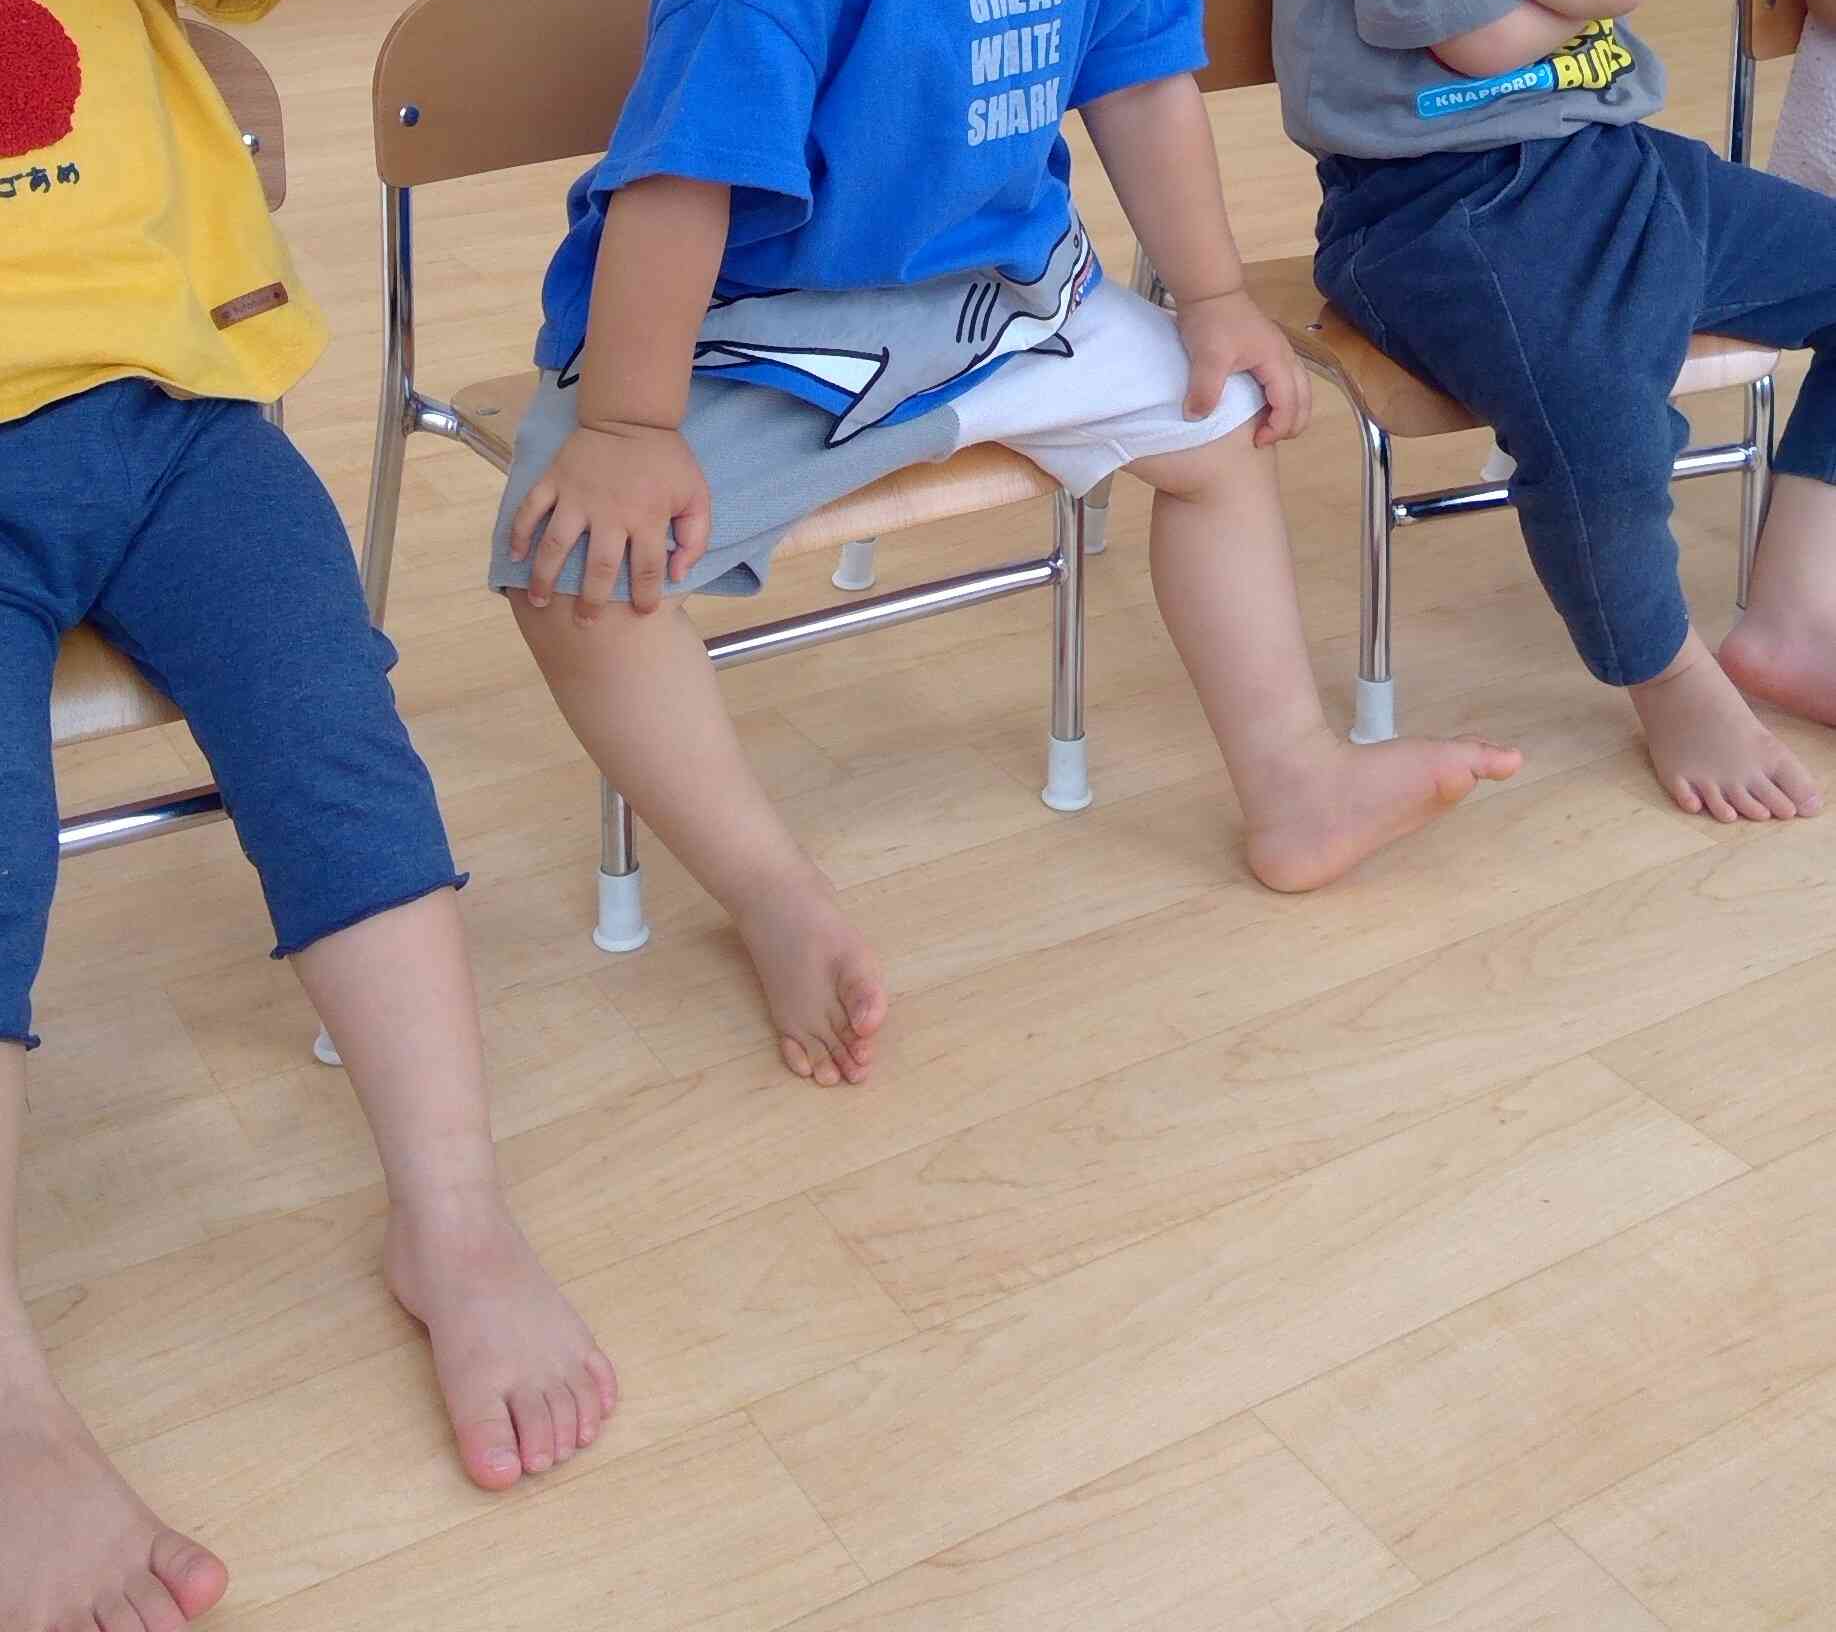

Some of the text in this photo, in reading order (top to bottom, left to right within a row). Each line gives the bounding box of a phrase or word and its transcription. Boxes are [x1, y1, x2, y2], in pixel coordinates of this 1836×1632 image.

[970, 18, 1061, 86] WHITE
[967, 76, 1060, 147] SHARK
[1435, 72, 1538, 107] KNAPFORD
